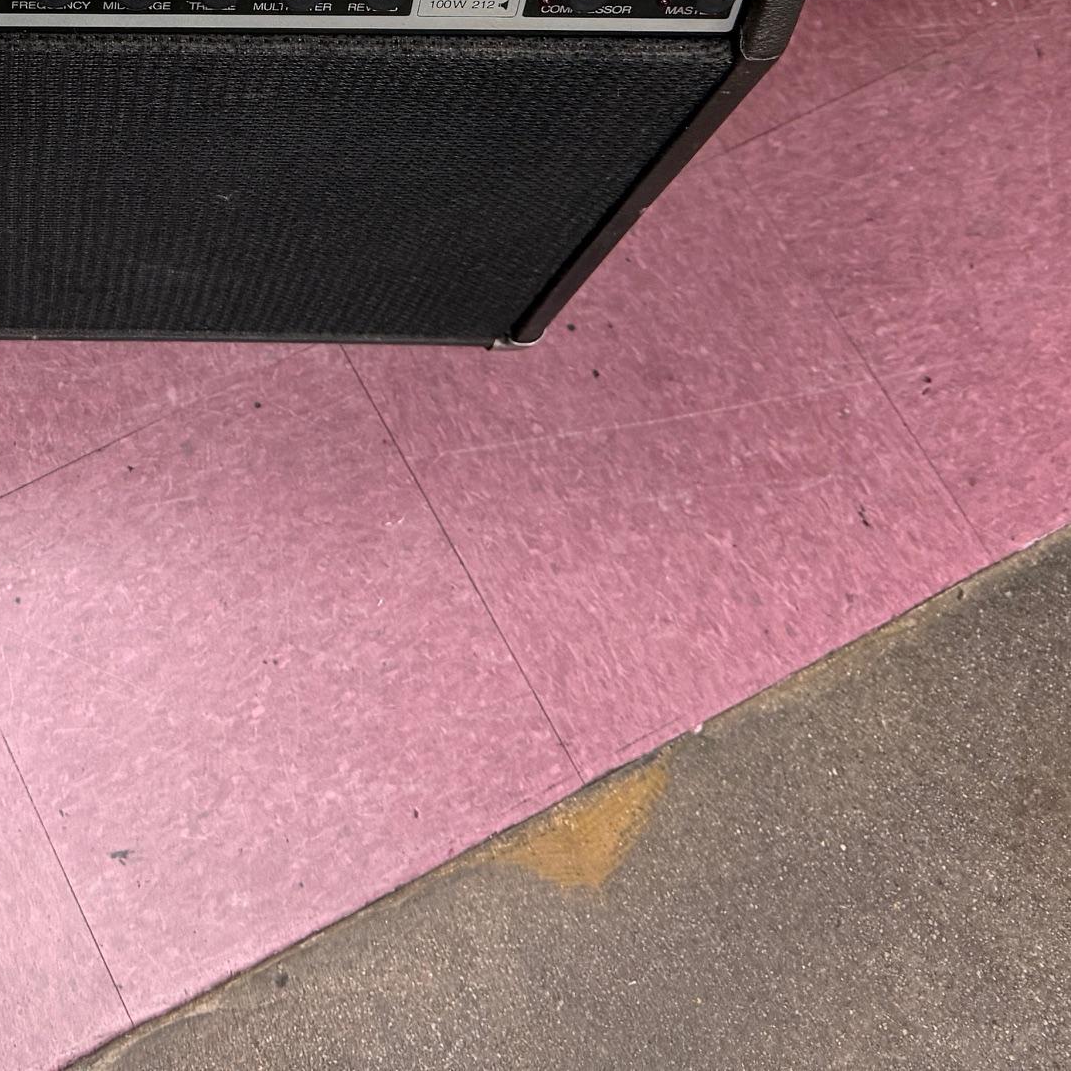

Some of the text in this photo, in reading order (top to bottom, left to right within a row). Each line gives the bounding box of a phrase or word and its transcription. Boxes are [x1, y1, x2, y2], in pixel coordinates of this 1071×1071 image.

[11, 1, 91, 10] FRENCY
[103, 2, 171, 10] MIGE
[430, 0, 495, 9] 100W 212
[541, 5, 632, 14] COMSSOR
